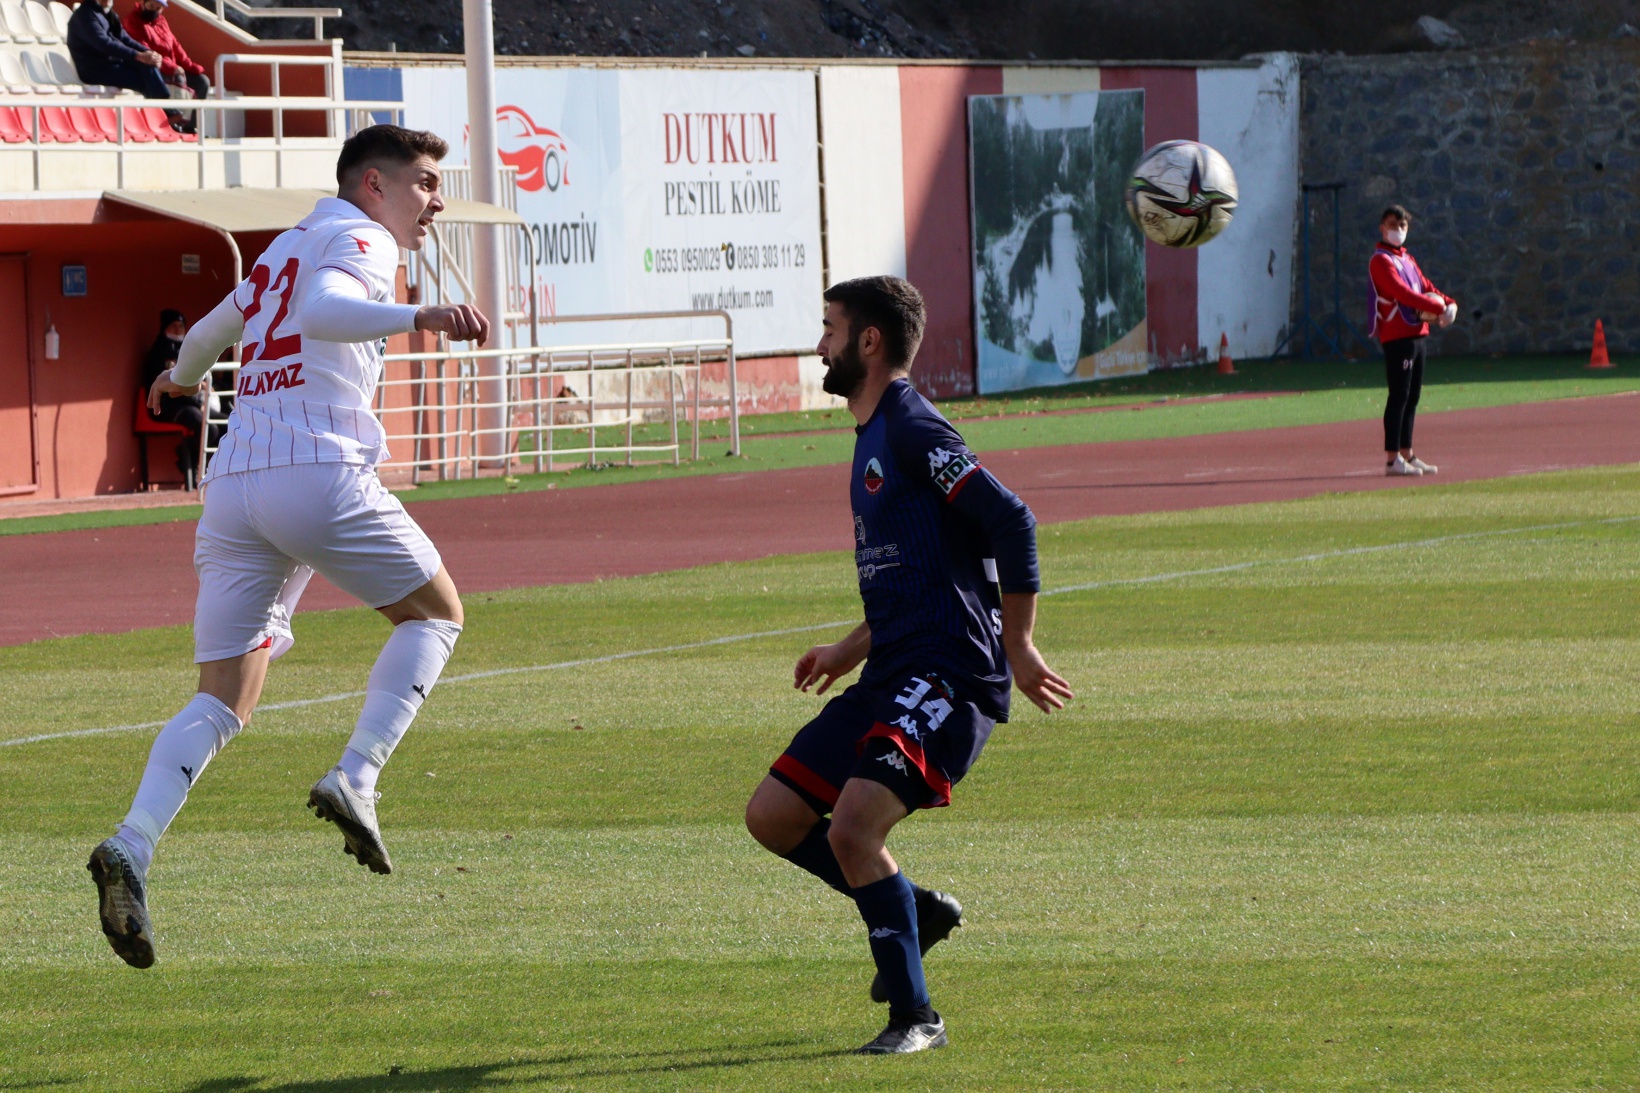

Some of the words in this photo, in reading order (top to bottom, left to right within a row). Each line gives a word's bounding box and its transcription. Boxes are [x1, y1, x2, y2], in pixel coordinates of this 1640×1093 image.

[663, 113, 778, 164] DUTKUM
[664, 171, 726, 216] PESTİL
[731, 169, 781, 214] KÖME
[655, 249, 679, 273] 0553
[682, 247, 721, 272] 0950029
[737, 245, 759, 270] 0850
[763, 245, 779, 269] 303
[782, 244, 792, 268] 11
[795, 243, 806, 268] 29
[240, 257, 302, 369] 22
[692, 285, 774, 311] www.dutkum.com
[894, 676, 954, 732] 34
